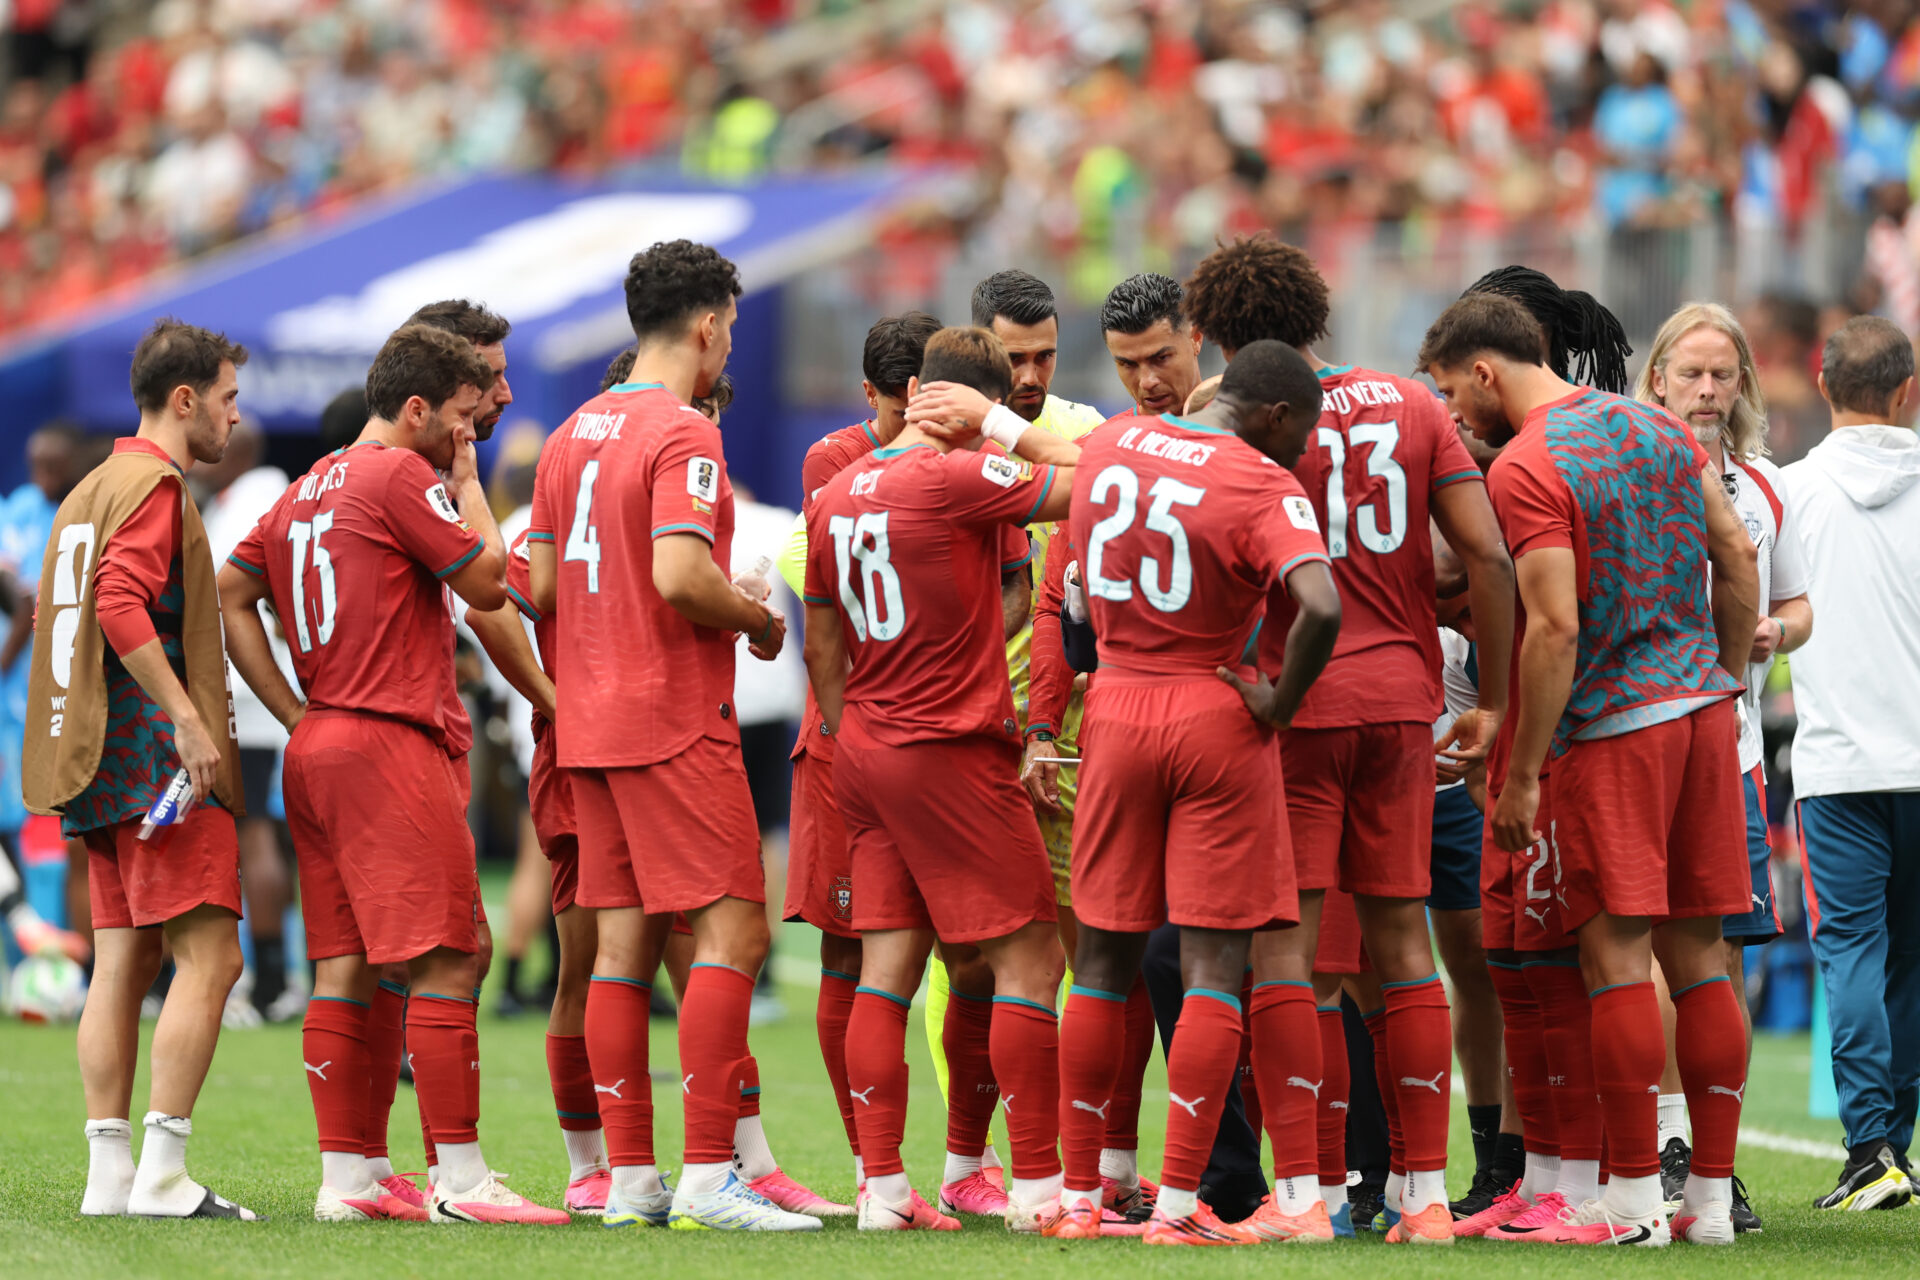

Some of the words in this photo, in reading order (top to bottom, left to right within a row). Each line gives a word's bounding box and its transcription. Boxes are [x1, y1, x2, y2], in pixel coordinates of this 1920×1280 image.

[1136, 430, 1217, 467] MENDES
[1345, 381, 1404, 405] VEIGA
[563, 459, 601, 593] 4
[1086, 464, 1206, 613] 25
[1317, 420, 1408, 559] 13
[287, 508, 338, 653] 15
[828, 510, 906, 643] 18
[154, 779, 186, 820] smart
